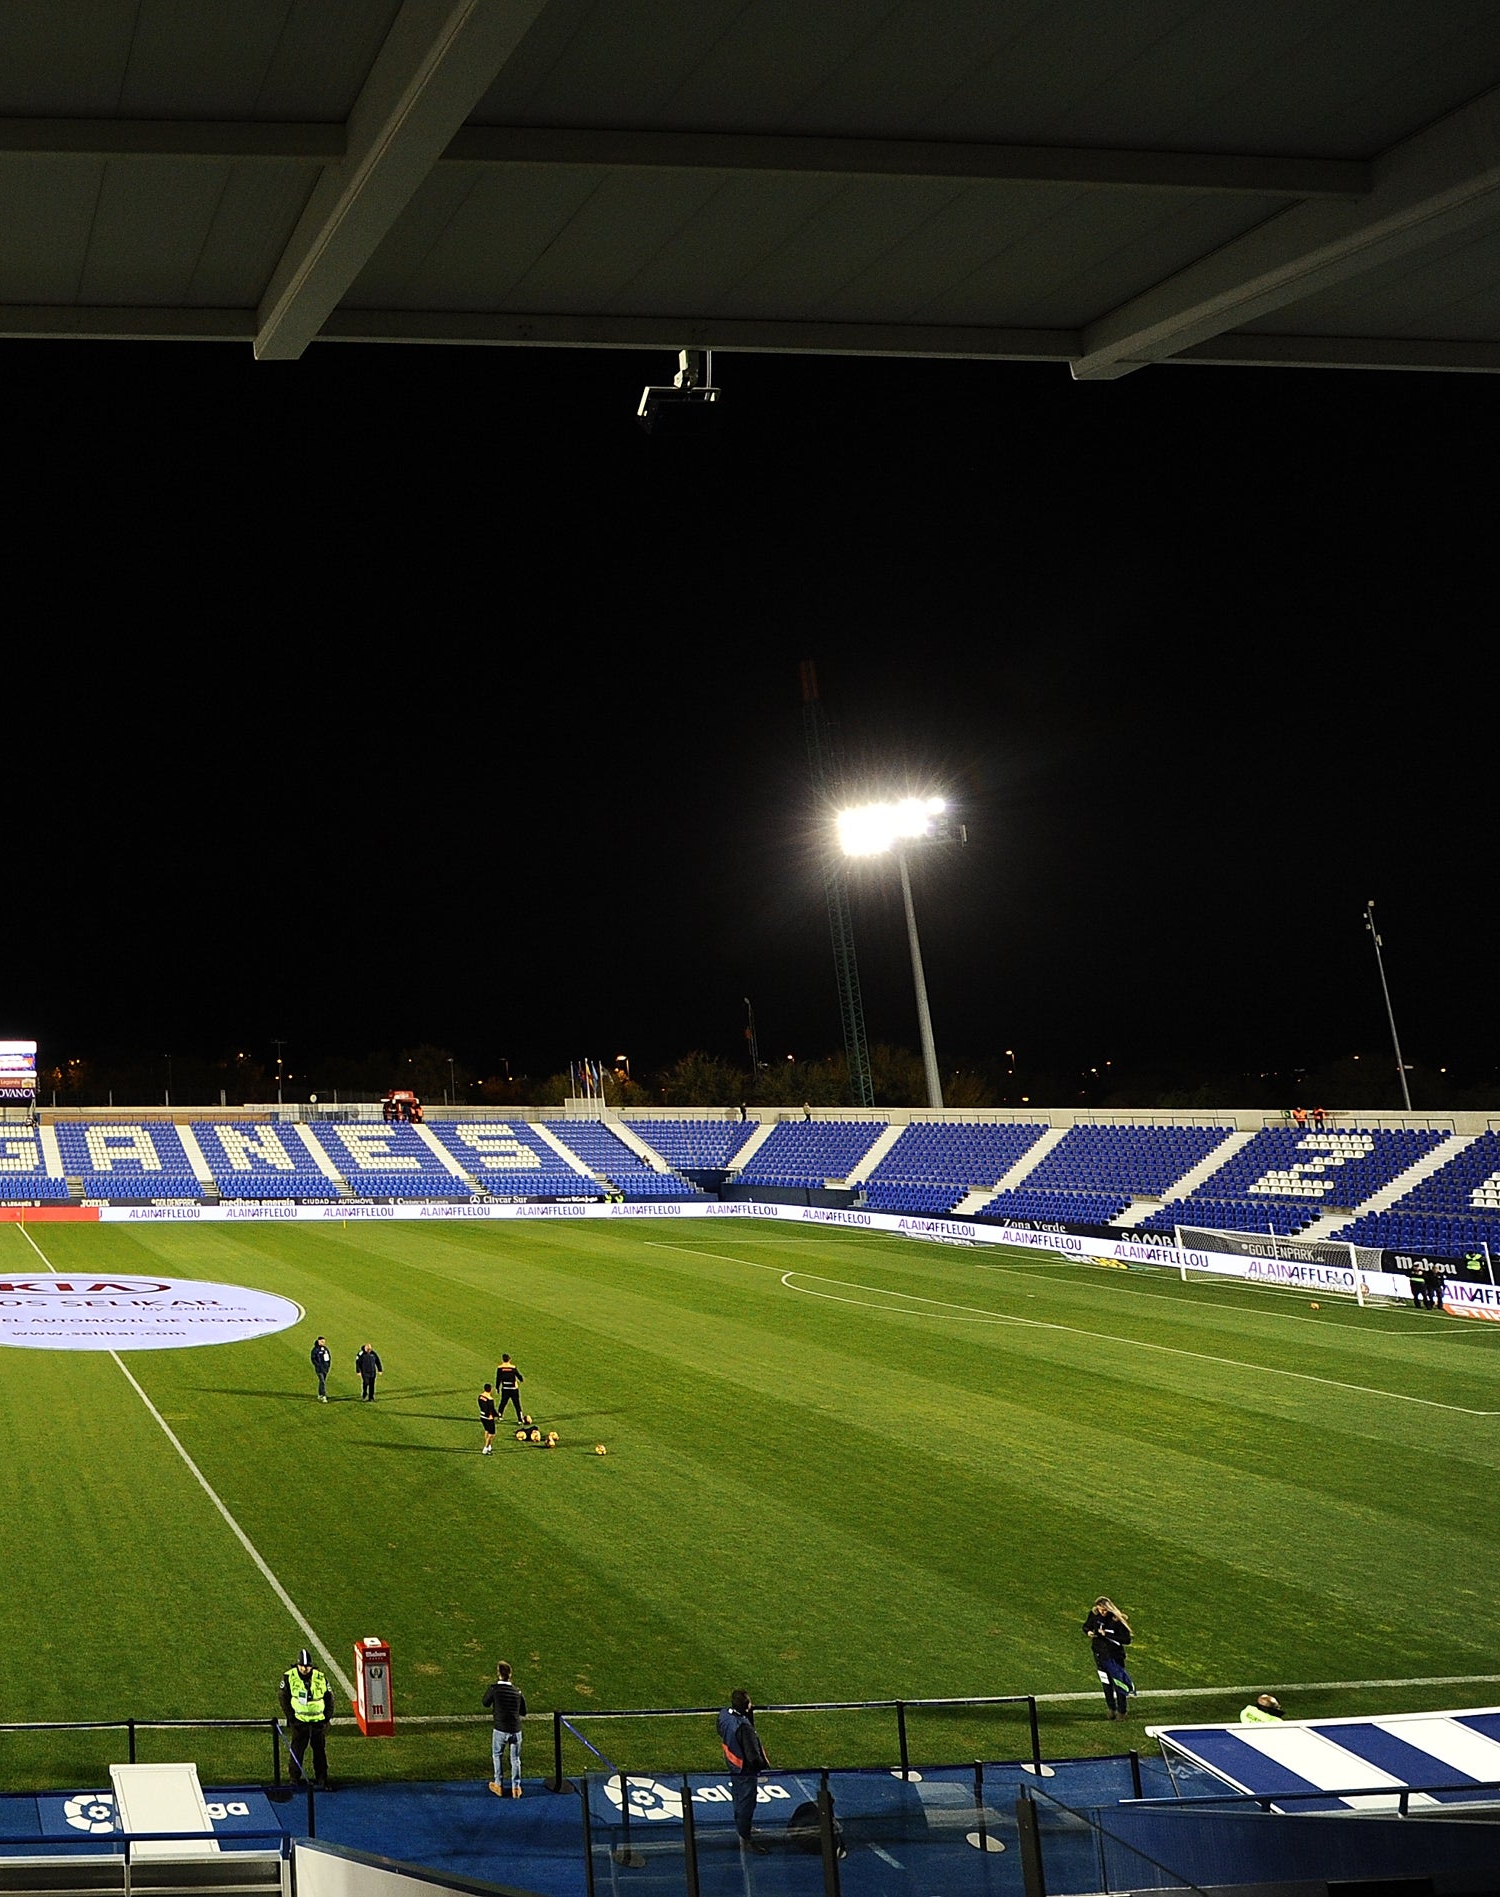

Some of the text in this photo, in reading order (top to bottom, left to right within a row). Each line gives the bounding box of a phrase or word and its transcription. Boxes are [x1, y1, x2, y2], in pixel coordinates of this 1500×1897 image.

[512, 1196, 527, 1204] Sur
[1003, 1218, 1069, 1233] Zona Verde
